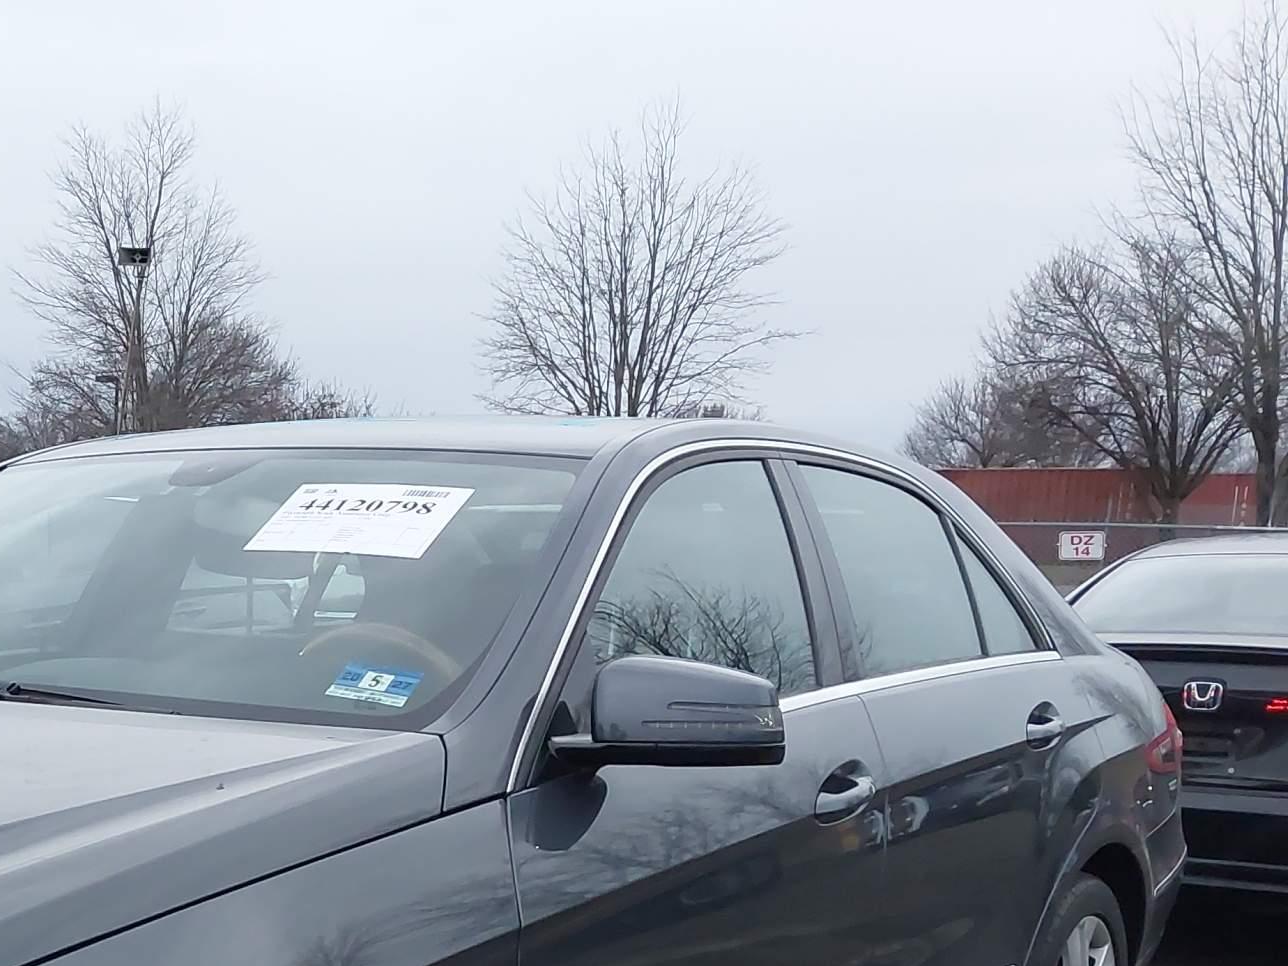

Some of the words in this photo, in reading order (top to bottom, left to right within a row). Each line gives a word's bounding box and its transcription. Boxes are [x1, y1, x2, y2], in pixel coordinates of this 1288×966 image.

[299, 498, 437, 515] 44120798
[1070, 535, 1095, 546] DZ
[1072, 546, 1091, 556] 14
[342, 671, 361, 682] 20
[368, 675, 384, 688] 5
[391, 680, 413, 690] 27
